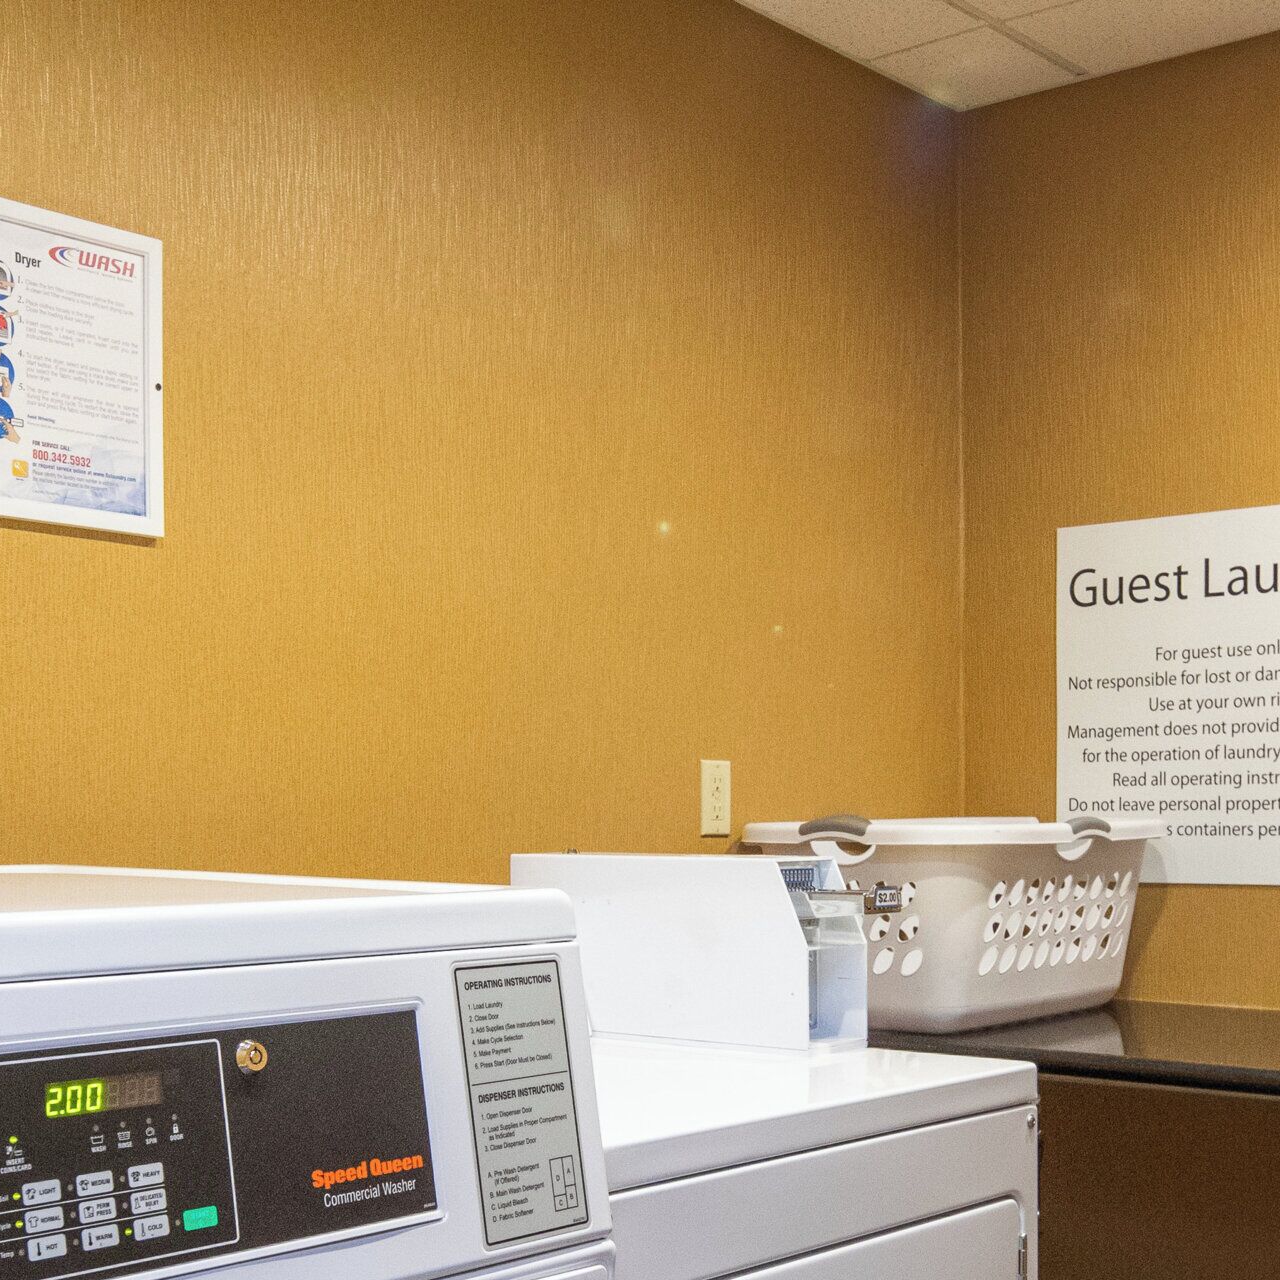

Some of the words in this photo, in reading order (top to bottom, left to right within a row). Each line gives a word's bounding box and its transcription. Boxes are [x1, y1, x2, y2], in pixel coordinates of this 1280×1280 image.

[15, 251, 41, 268] Dryer
[78, 249, 134, 277] WASH
[32, 449, 90, 467] 800.342.5932
[1069, 565, 1188, 607] Guest
[1155, 646, 1177, 661] For
[1181, 645, 1222, 663] guest
[1226, 645, 1252, 657] use
[1068, 676, 1092, 690] Not
[1096, 671, 1176, 691] responsible
[1180, 669, 1200, 684] for
[1205, 669, 1231, 683] lost
[1235, 670, 1250, 682] or
[1149, 697, 1174, 711] Use
[1178, 697, 1191, 710] at
[1196, 697, 1229, 713] your
[1233, 696, 1265, 708] own
[1067, 724, 1159, 741] Management
[1163, 721, 1197, 735] does
[1202, 721, 1226, 734] not
[1082, 748, 1101, 762] for
[1104, 747, 1127, 762] the
[1131, 746, 1200, 764] operation
[1204, 744, 1220, 760] of
[1223, 743, 1280, 762] laundry
[1113, 771, 1146, 786] Read
[1150, 771, 1166, 786] all
[1170, 770, 1241, 789] operating
[1068, 797, 1087, 811] Do
[1092, 799, 1114, 811] not
[1119, 796, 1155, 811] leave
[1159, 795, 1220, 814] personal
[1176, 821, 1253, 836] containers
[878, 892, 897, 903] $2.00
[464, 978, 503, 990] OPERATING
[503, 974, 551, 986] INSTRUCTIONS
[472, 1002, 484, 1010] Load
[489, 1036, 503, 1044] Cycle
[491, 1047, 511, 1055] Payment
[493, 1059, 504, 1067] Start
[45, 1082, 102, 1116] 2.00
[477, 1089, 516, 1103] DISPENSER
[517, 1081, 564, 1097] INSTRUCTIONS
[498, 1109, 521, 1117] Dispenser
[487, 1125, 499, 1133] Load
[499, 1122, 518, 1131] Supplies
[538, 1113, 567, 1124] Compartment
[494, 1131, 515, 1139] Indicated
[503, 1139, 525, 1148] Dispenser
[311, 1160, 368, 1190] Speed
[371, 1154, 424, 1177] Queen
[91, 1178, 110, 1186] MEDIUM
[38, 1187, 55, 1195] LIGHT
[324, 1184, 381, 1207] Commercial
[382, 1179, 417, 1196] Washer
[147, 1223, 162, 1231] COLD
